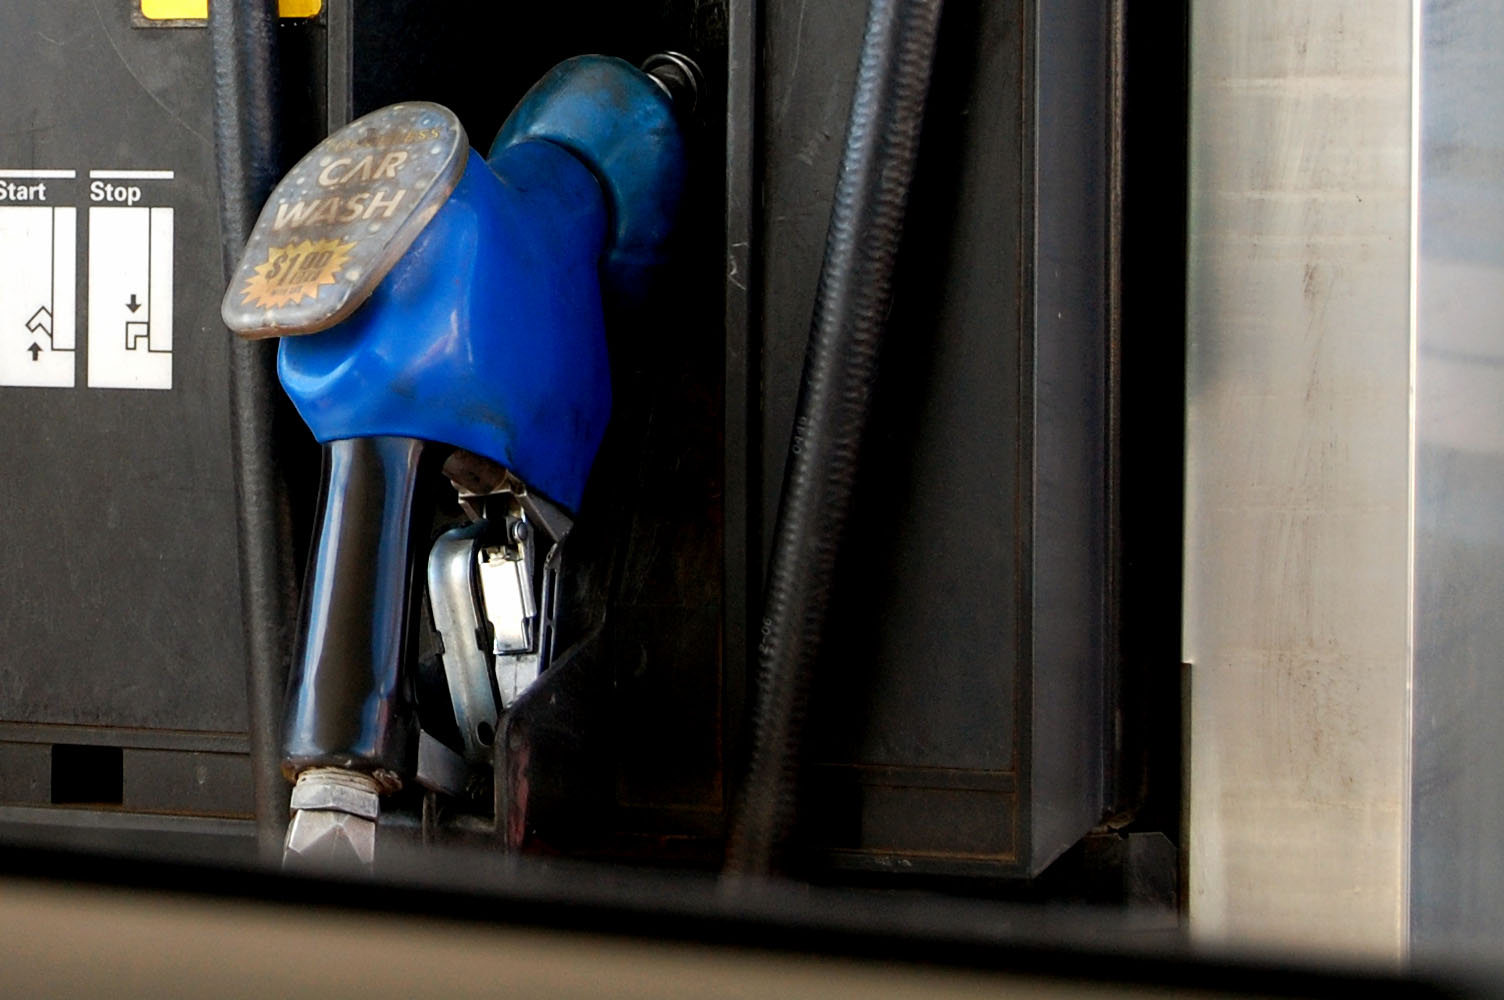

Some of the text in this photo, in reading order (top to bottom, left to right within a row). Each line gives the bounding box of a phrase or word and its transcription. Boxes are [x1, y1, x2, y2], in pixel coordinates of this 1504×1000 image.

[318, 151, 408, 186] CAR
[90, 181, 142, 206] Stop
[272, 189, 407, 231] WASH
